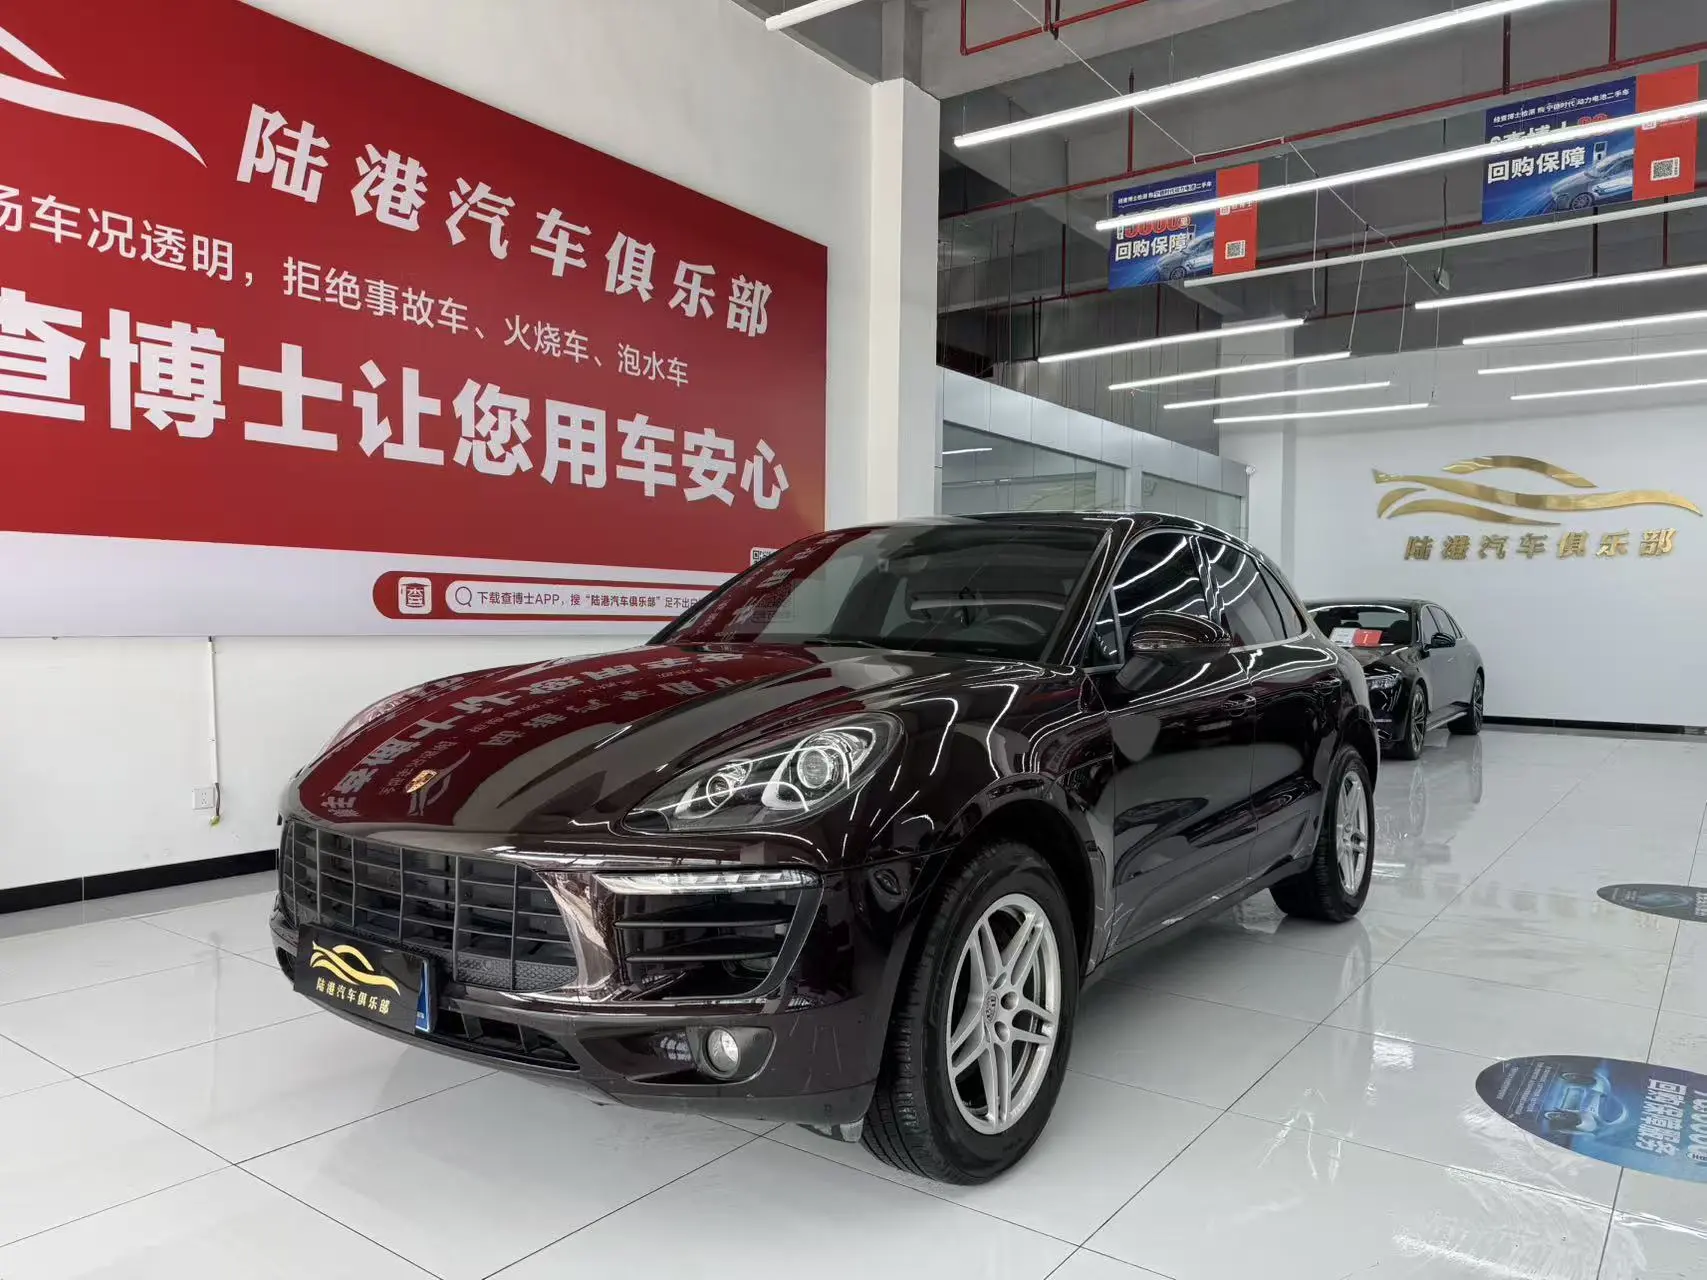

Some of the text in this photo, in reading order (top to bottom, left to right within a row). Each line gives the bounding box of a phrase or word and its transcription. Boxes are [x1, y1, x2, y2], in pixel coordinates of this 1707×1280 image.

[1487, 146, 1585, 184] 回购保障
[236, 103, 772, 337] 陆港汽车俱乐部
[1115, 232, 1187, 262] 回购保障
[0, 287, 790, 510] 查博士让您用车安心
[1404, 527, 1678, 561] 陆港汽车俱乐部
[315, 977, 391, 1015] 陆港汽车俱乐部
[1635, 1078, 1689, 1157] 回购保障服务
